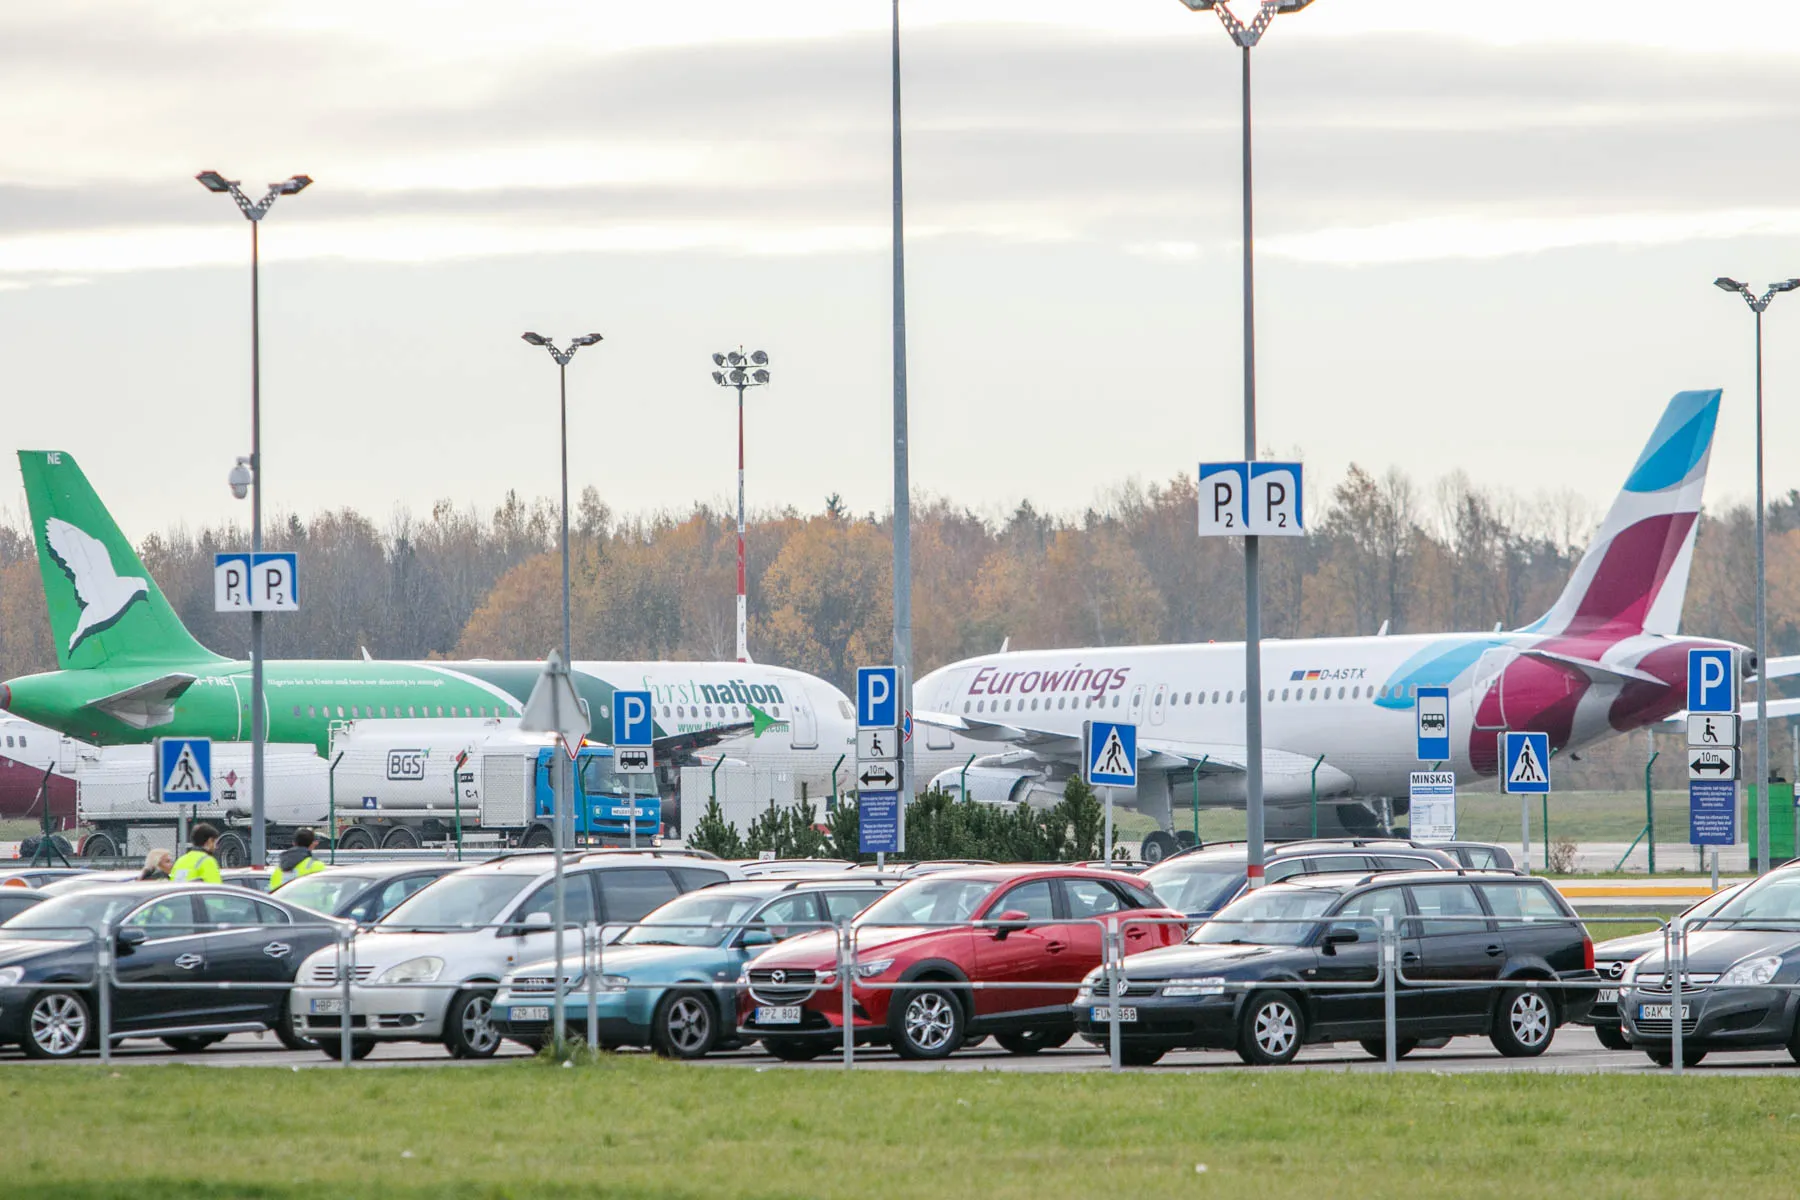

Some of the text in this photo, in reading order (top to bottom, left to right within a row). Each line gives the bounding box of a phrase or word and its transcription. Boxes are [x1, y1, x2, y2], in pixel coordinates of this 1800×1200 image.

[47, 452, 61, 465] NE
[1320, 667, 1367, 681] D-ASTX
[968, 662, 1131, 701] Eurowings
[1700, 656, 1724, 706] P
[868, 674, 889, 721] P
[624, 696, 645, 740] P
[391, 755, 421, 774] BGS
[1411, 774, 1453, 785] MINSKAS
[1599, 990, 1612, 1001] NV
[532, 1008, 548, 1019] 112
[759, 1008, 799, 1019] KPZ 802
[1644, 1006, 1664, 1018] GAK
